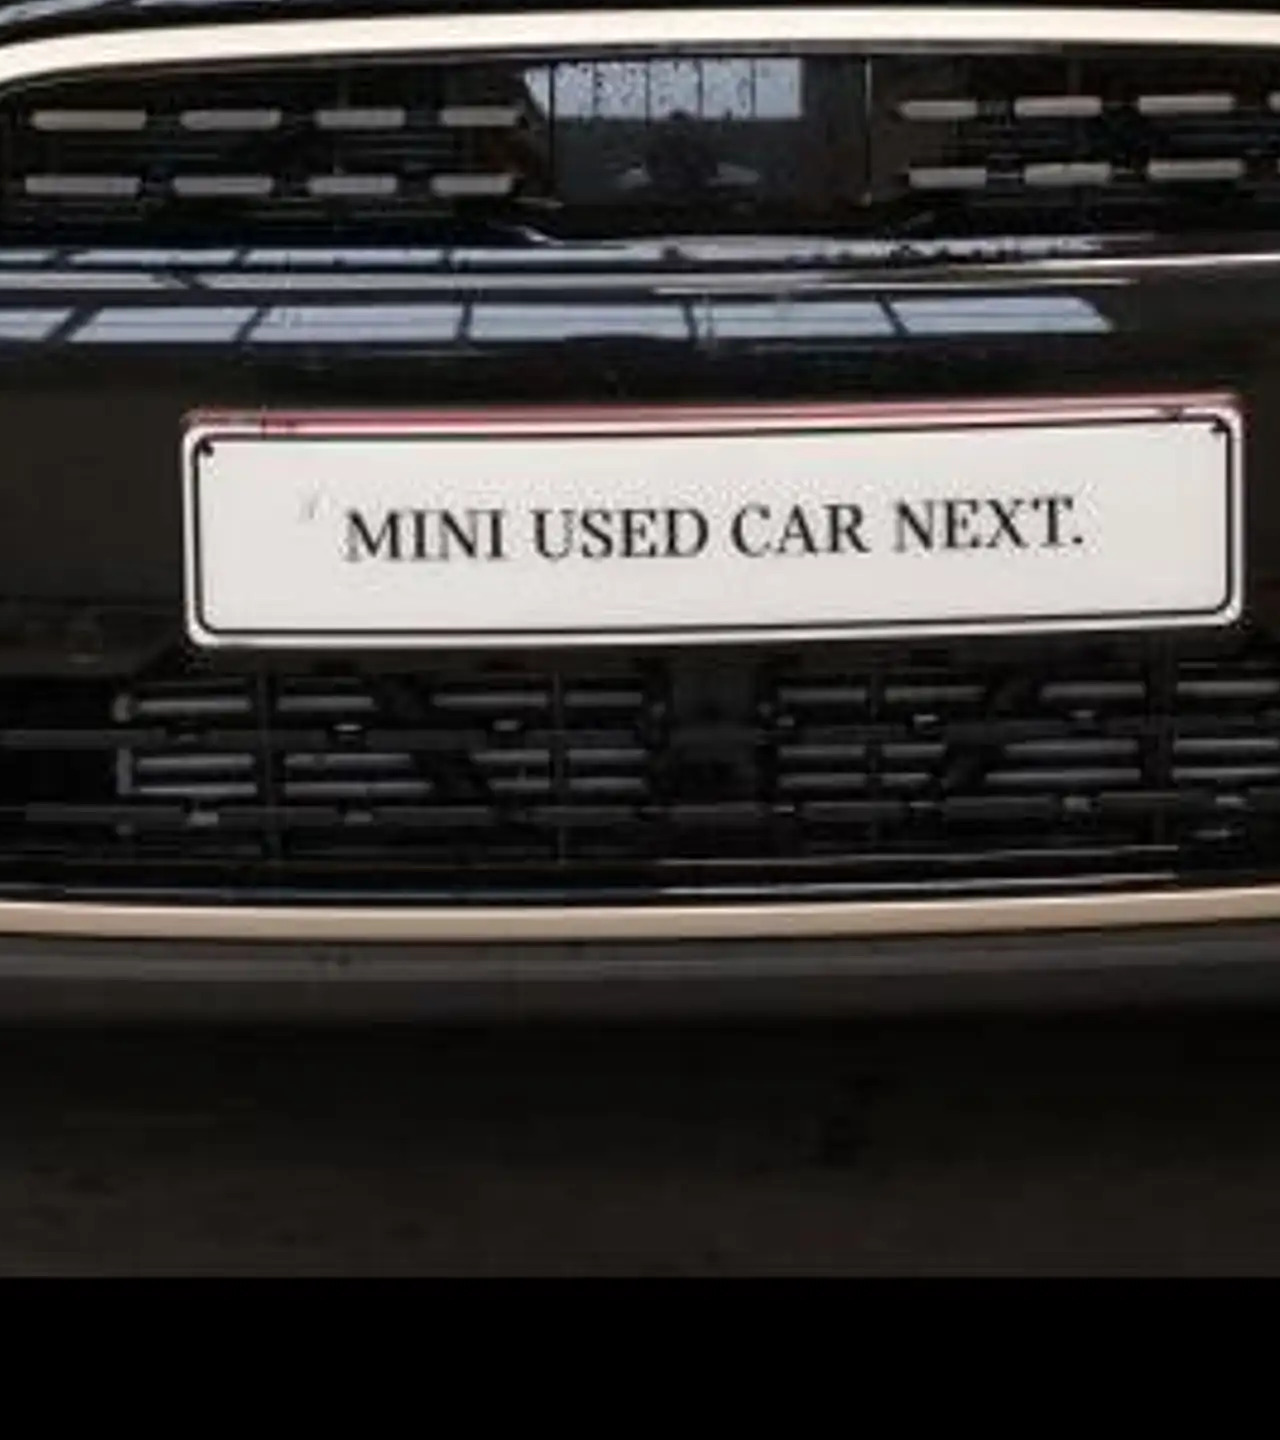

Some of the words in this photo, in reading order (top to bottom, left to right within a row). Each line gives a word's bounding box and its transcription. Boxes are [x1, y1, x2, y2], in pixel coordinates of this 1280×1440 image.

[344, 508, 508, 562] MINI
[529, 507, 710, 561] USED
[730, 502, 871, 558] CAR
[891, 495, 1085, 554] NEXT.
